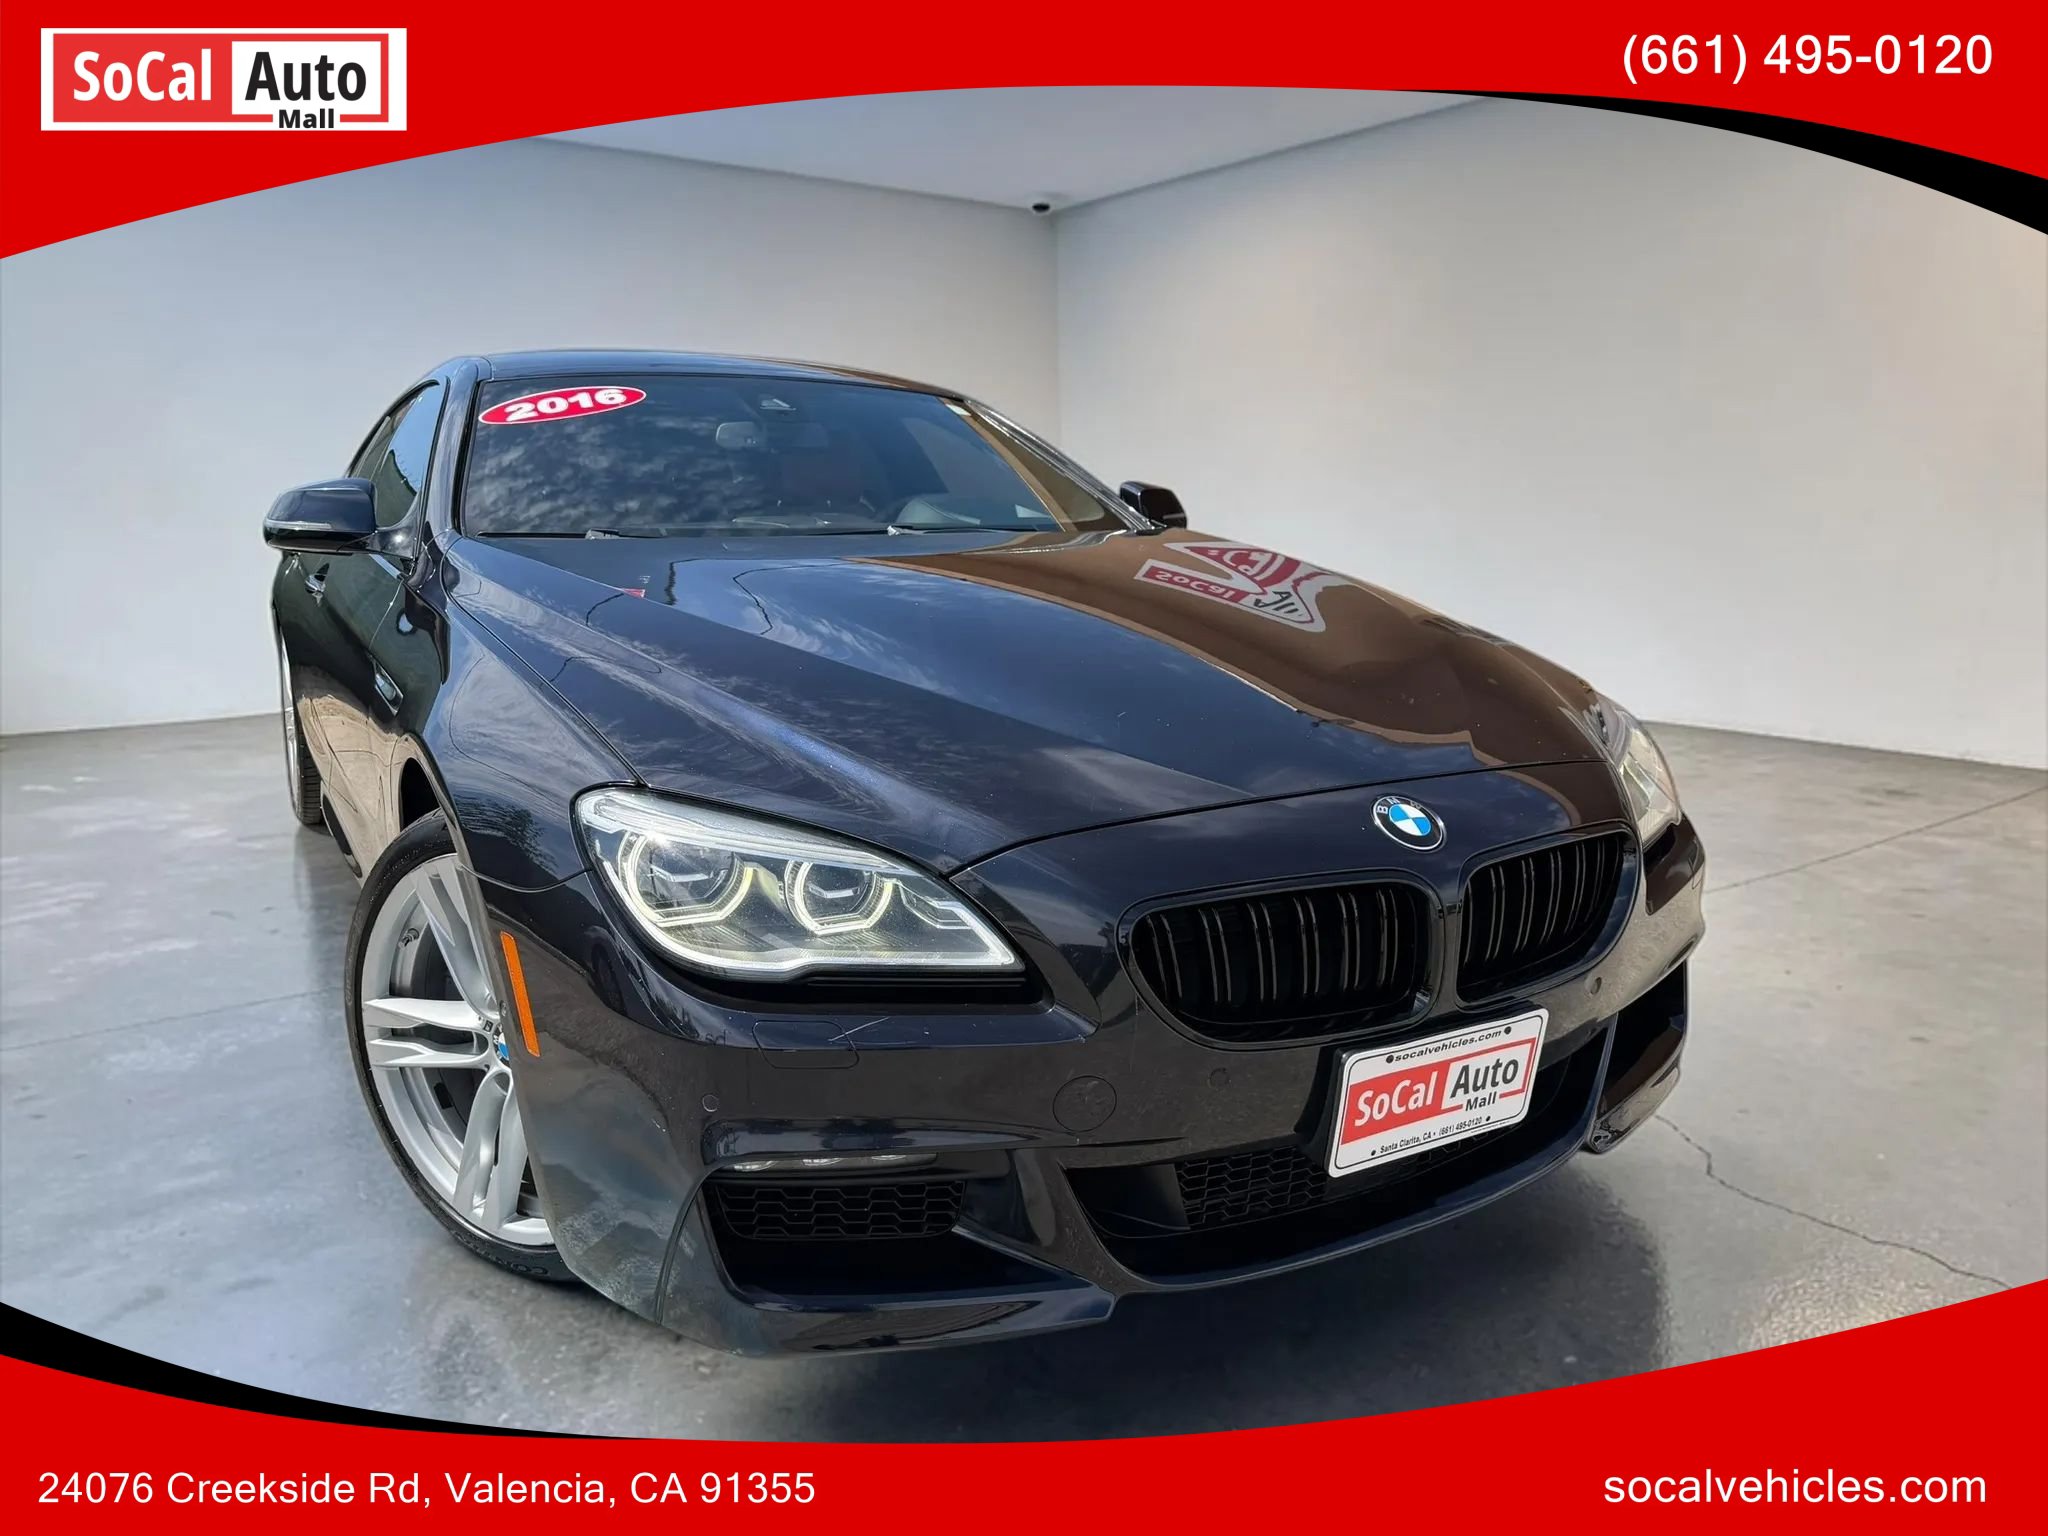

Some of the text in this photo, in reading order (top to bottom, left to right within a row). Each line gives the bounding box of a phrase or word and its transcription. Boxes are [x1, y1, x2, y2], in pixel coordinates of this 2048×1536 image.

[504, 388, 627, 422] 2016
[1394, 1029, 1502, 1062] socalvehicles.com
[1354, 1057, 1519, 1127] SoCal Auto
[1465, 1092, 1497, 1112] Mall
[1380, 1141, 1398, 1154] Santa
[1422, 1131, 1431, 1141] CA
[1455, 1117, 1483, 1131] 495-0120
